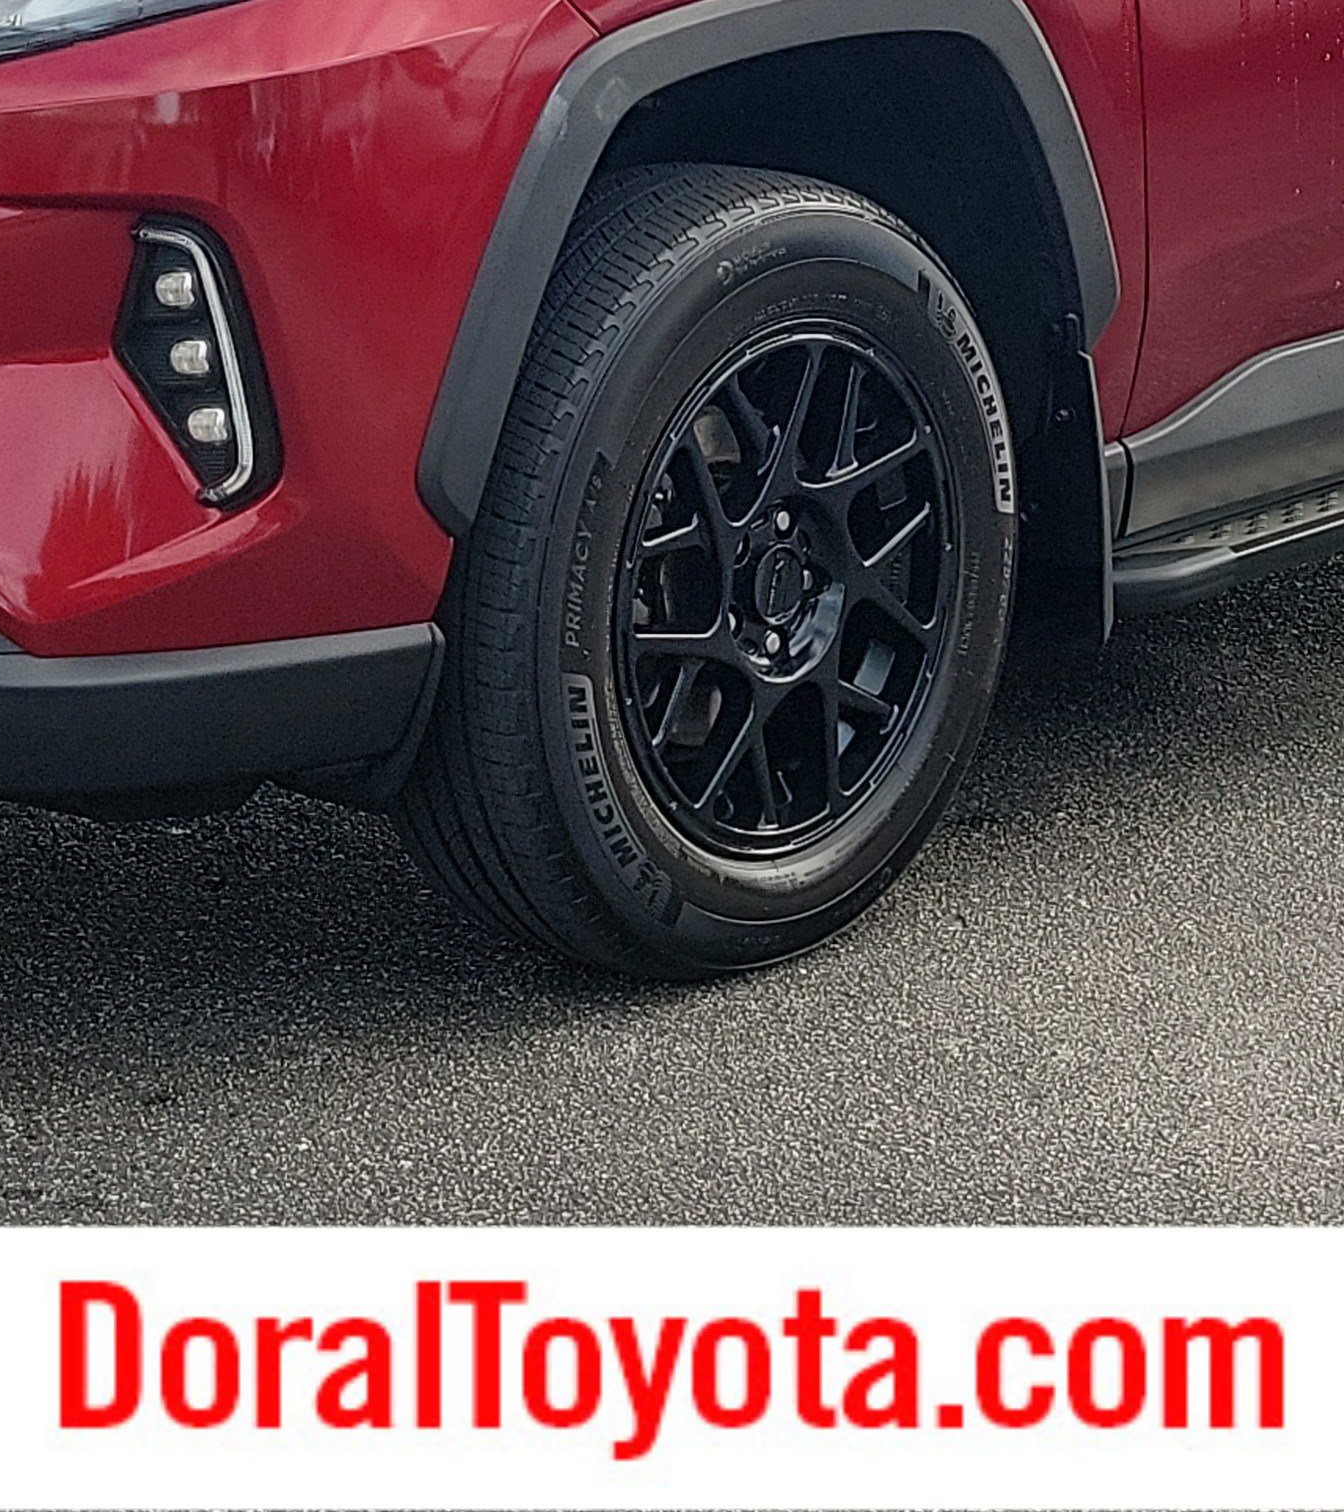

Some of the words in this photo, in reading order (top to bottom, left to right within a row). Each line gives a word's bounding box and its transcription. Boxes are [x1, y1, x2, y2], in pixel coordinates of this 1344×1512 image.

[957, 332, 1011, 503] MICHELIN
[565, 518, 594, 648] PRIMACY
[567, 685, 639, 869] MICHELIN
